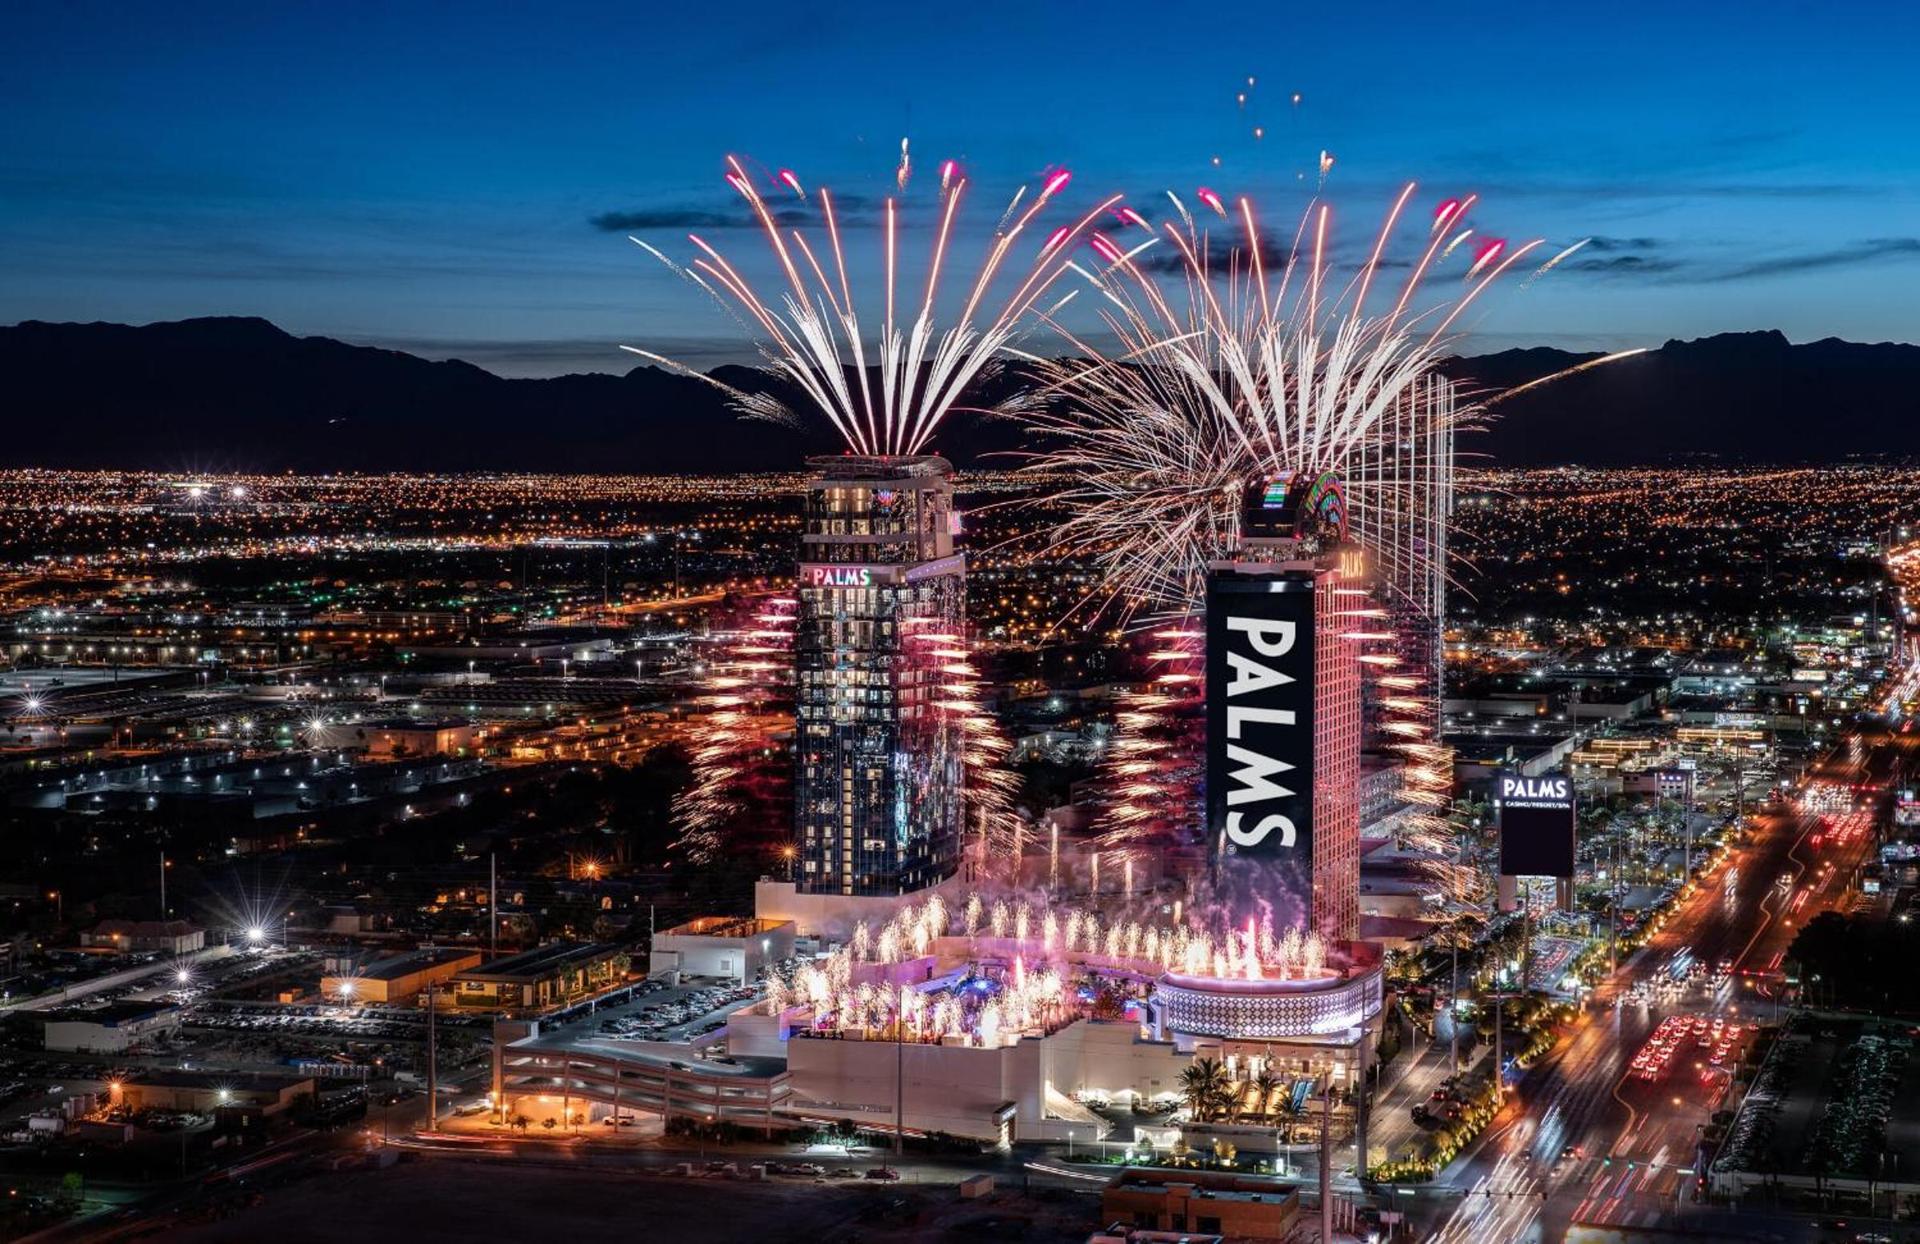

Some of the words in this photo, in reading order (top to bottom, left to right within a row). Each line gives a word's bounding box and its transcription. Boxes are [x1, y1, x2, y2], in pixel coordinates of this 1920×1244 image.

[814, 568, 871, 585] PALMS
[1226, 616, 1297, 848] PALMS
[1503, 778, 1567, 798] PALMS
